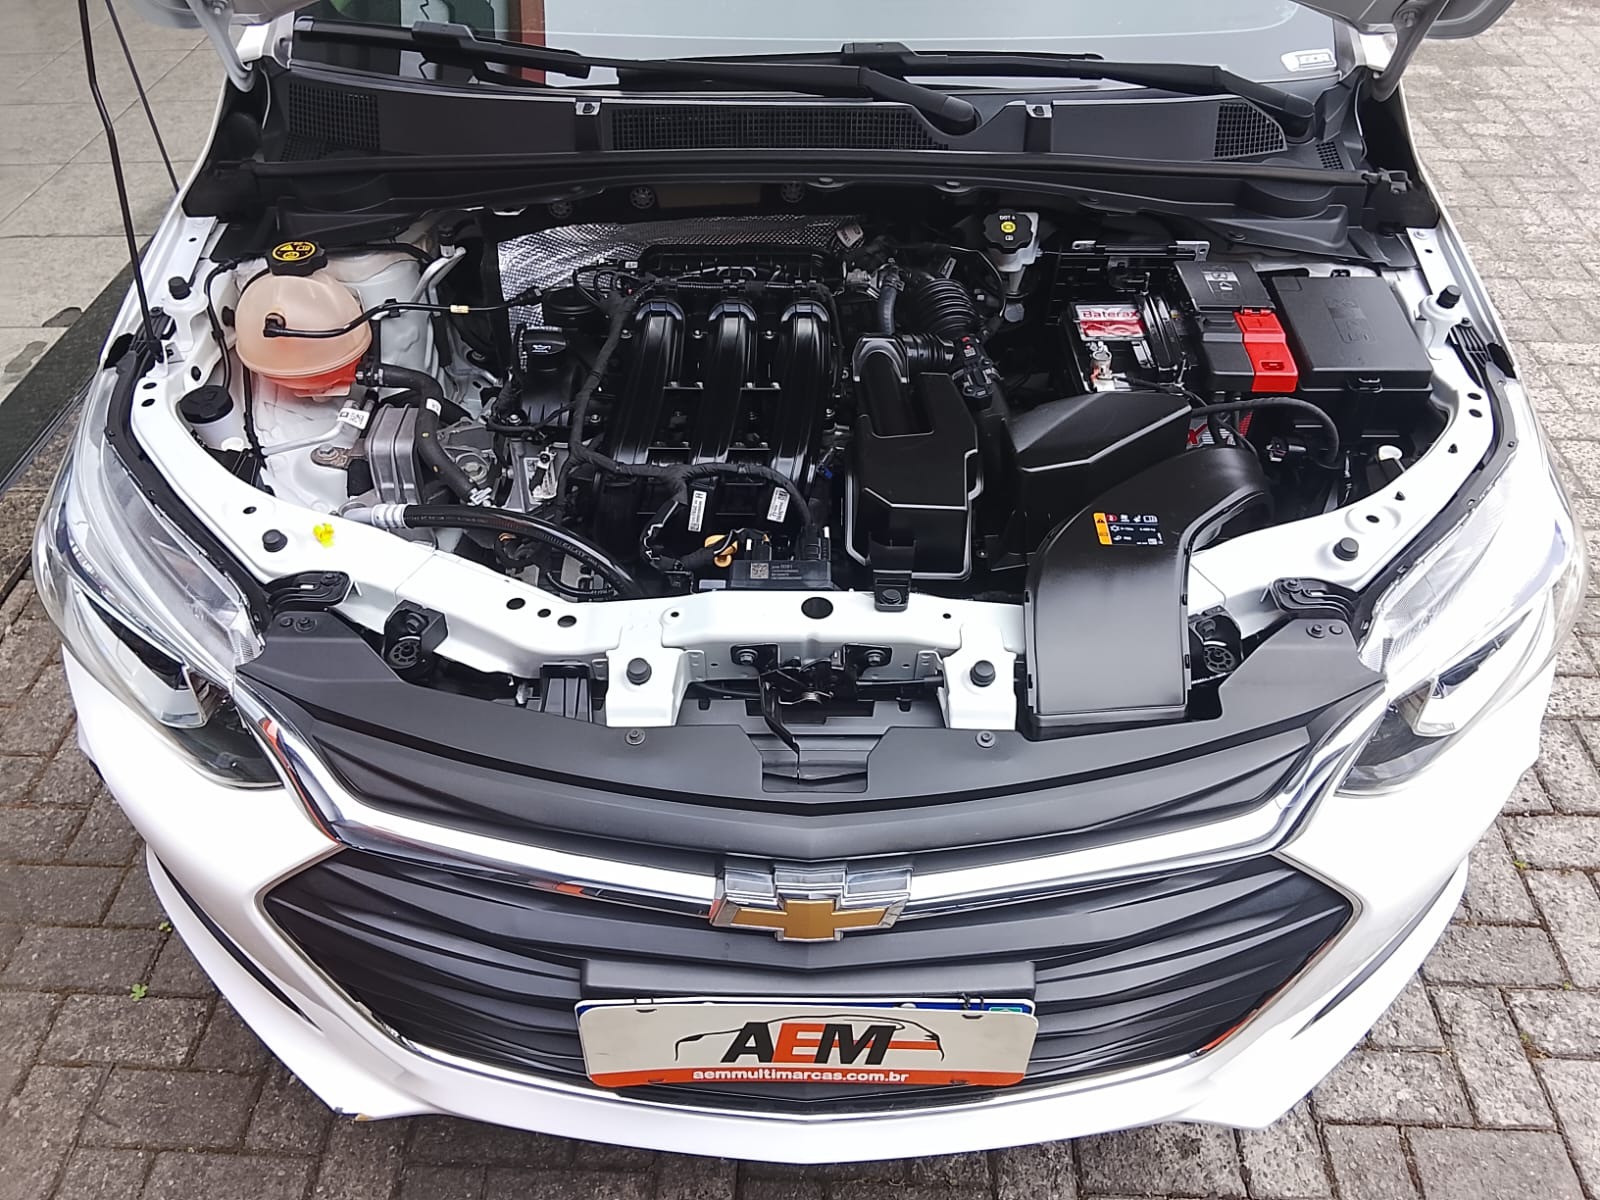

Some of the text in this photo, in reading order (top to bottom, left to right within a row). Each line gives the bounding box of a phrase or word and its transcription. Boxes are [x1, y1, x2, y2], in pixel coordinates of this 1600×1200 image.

[1082, 310, 1138, 319] Baterax
[720, 1021, 897, 1065] AEM
[693, 1069, 909, 1084] aemmultimarcas.com.br
